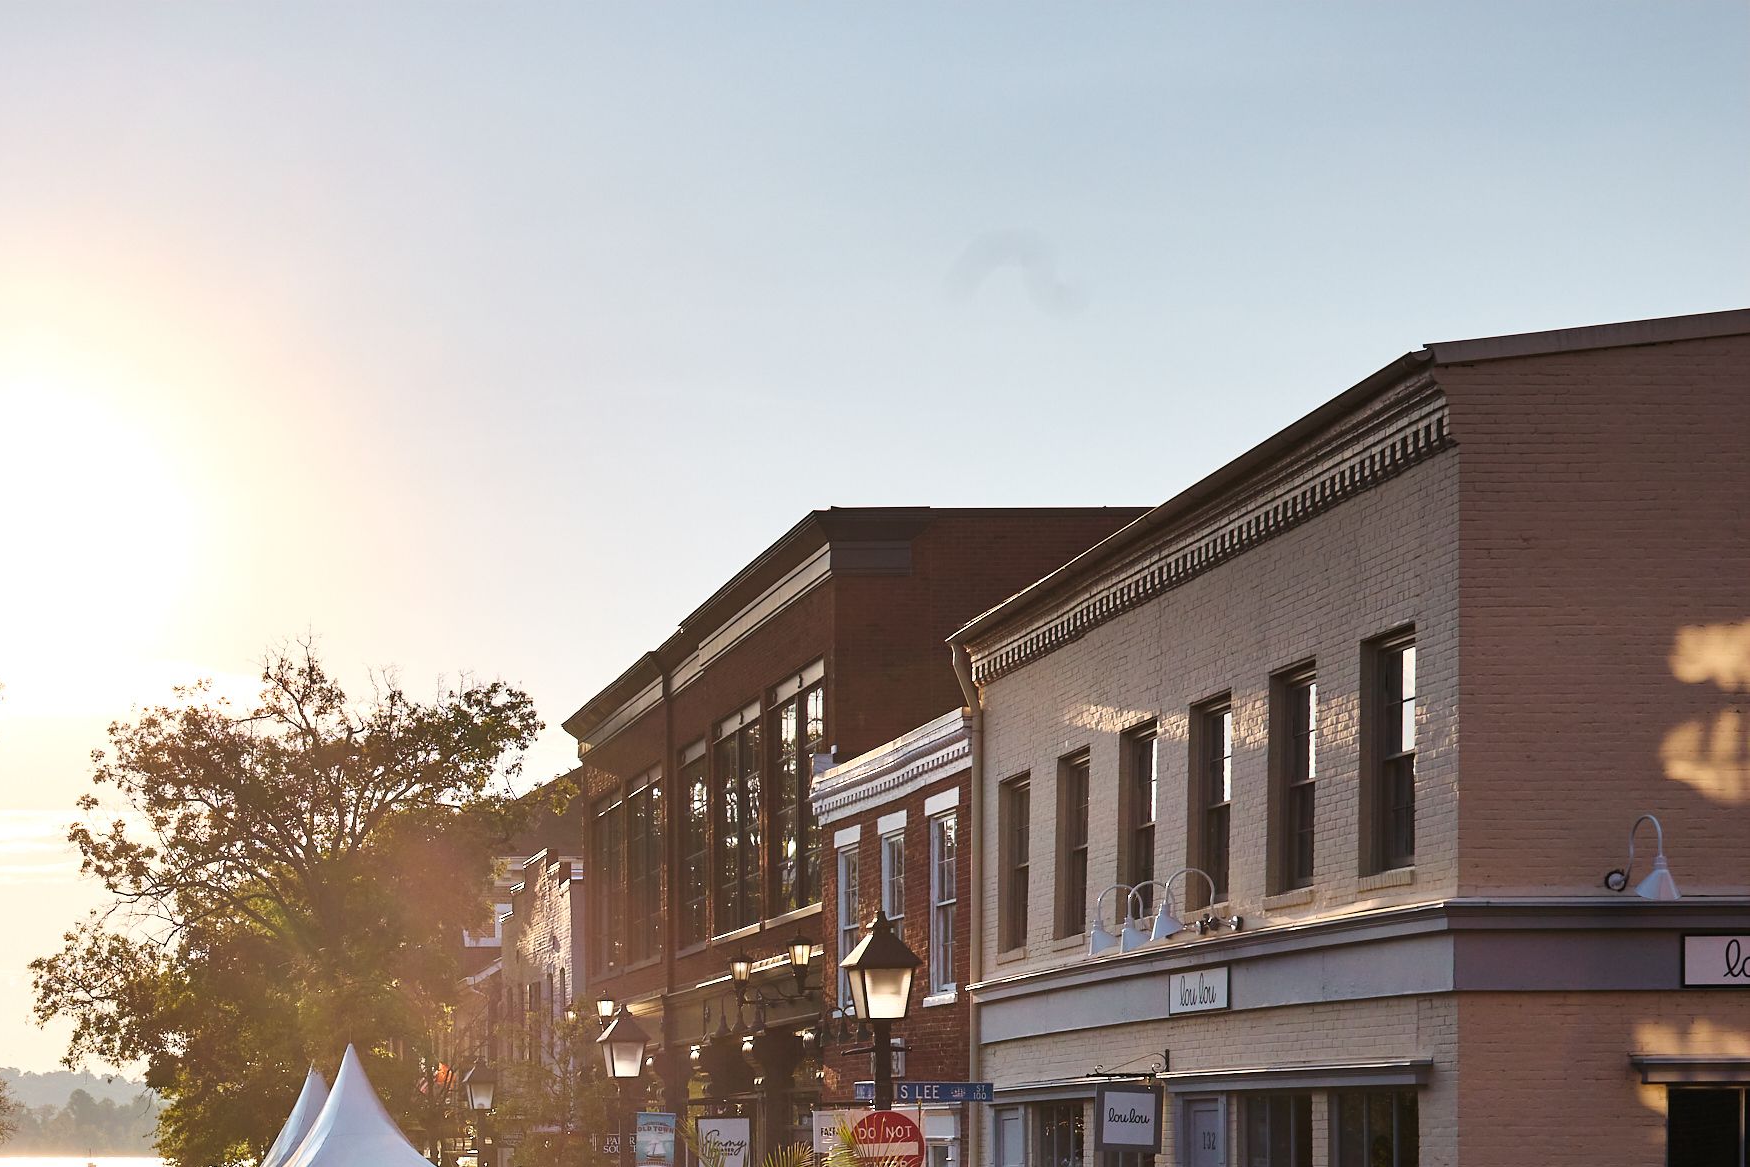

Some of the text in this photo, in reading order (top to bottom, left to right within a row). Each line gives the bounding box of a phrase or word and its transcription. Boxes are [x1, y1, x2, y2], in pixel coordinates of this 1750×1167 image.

[1179, 972, 1217, 1007] lou lou
[900, 1084, 940, 1100] S LEE
[976, 1084, 986, 1092] ST
[973, 1092, 987, 1100] 100
[1108, 1107, 1150, 1124] lou lou
[653, 1126, 674, 1134] TOWN
[858, 1125, 913, 1140] DO NOT
[606, 1136, 636, 1145] PAR
[1202, 1131, 1217, 1150] 132
